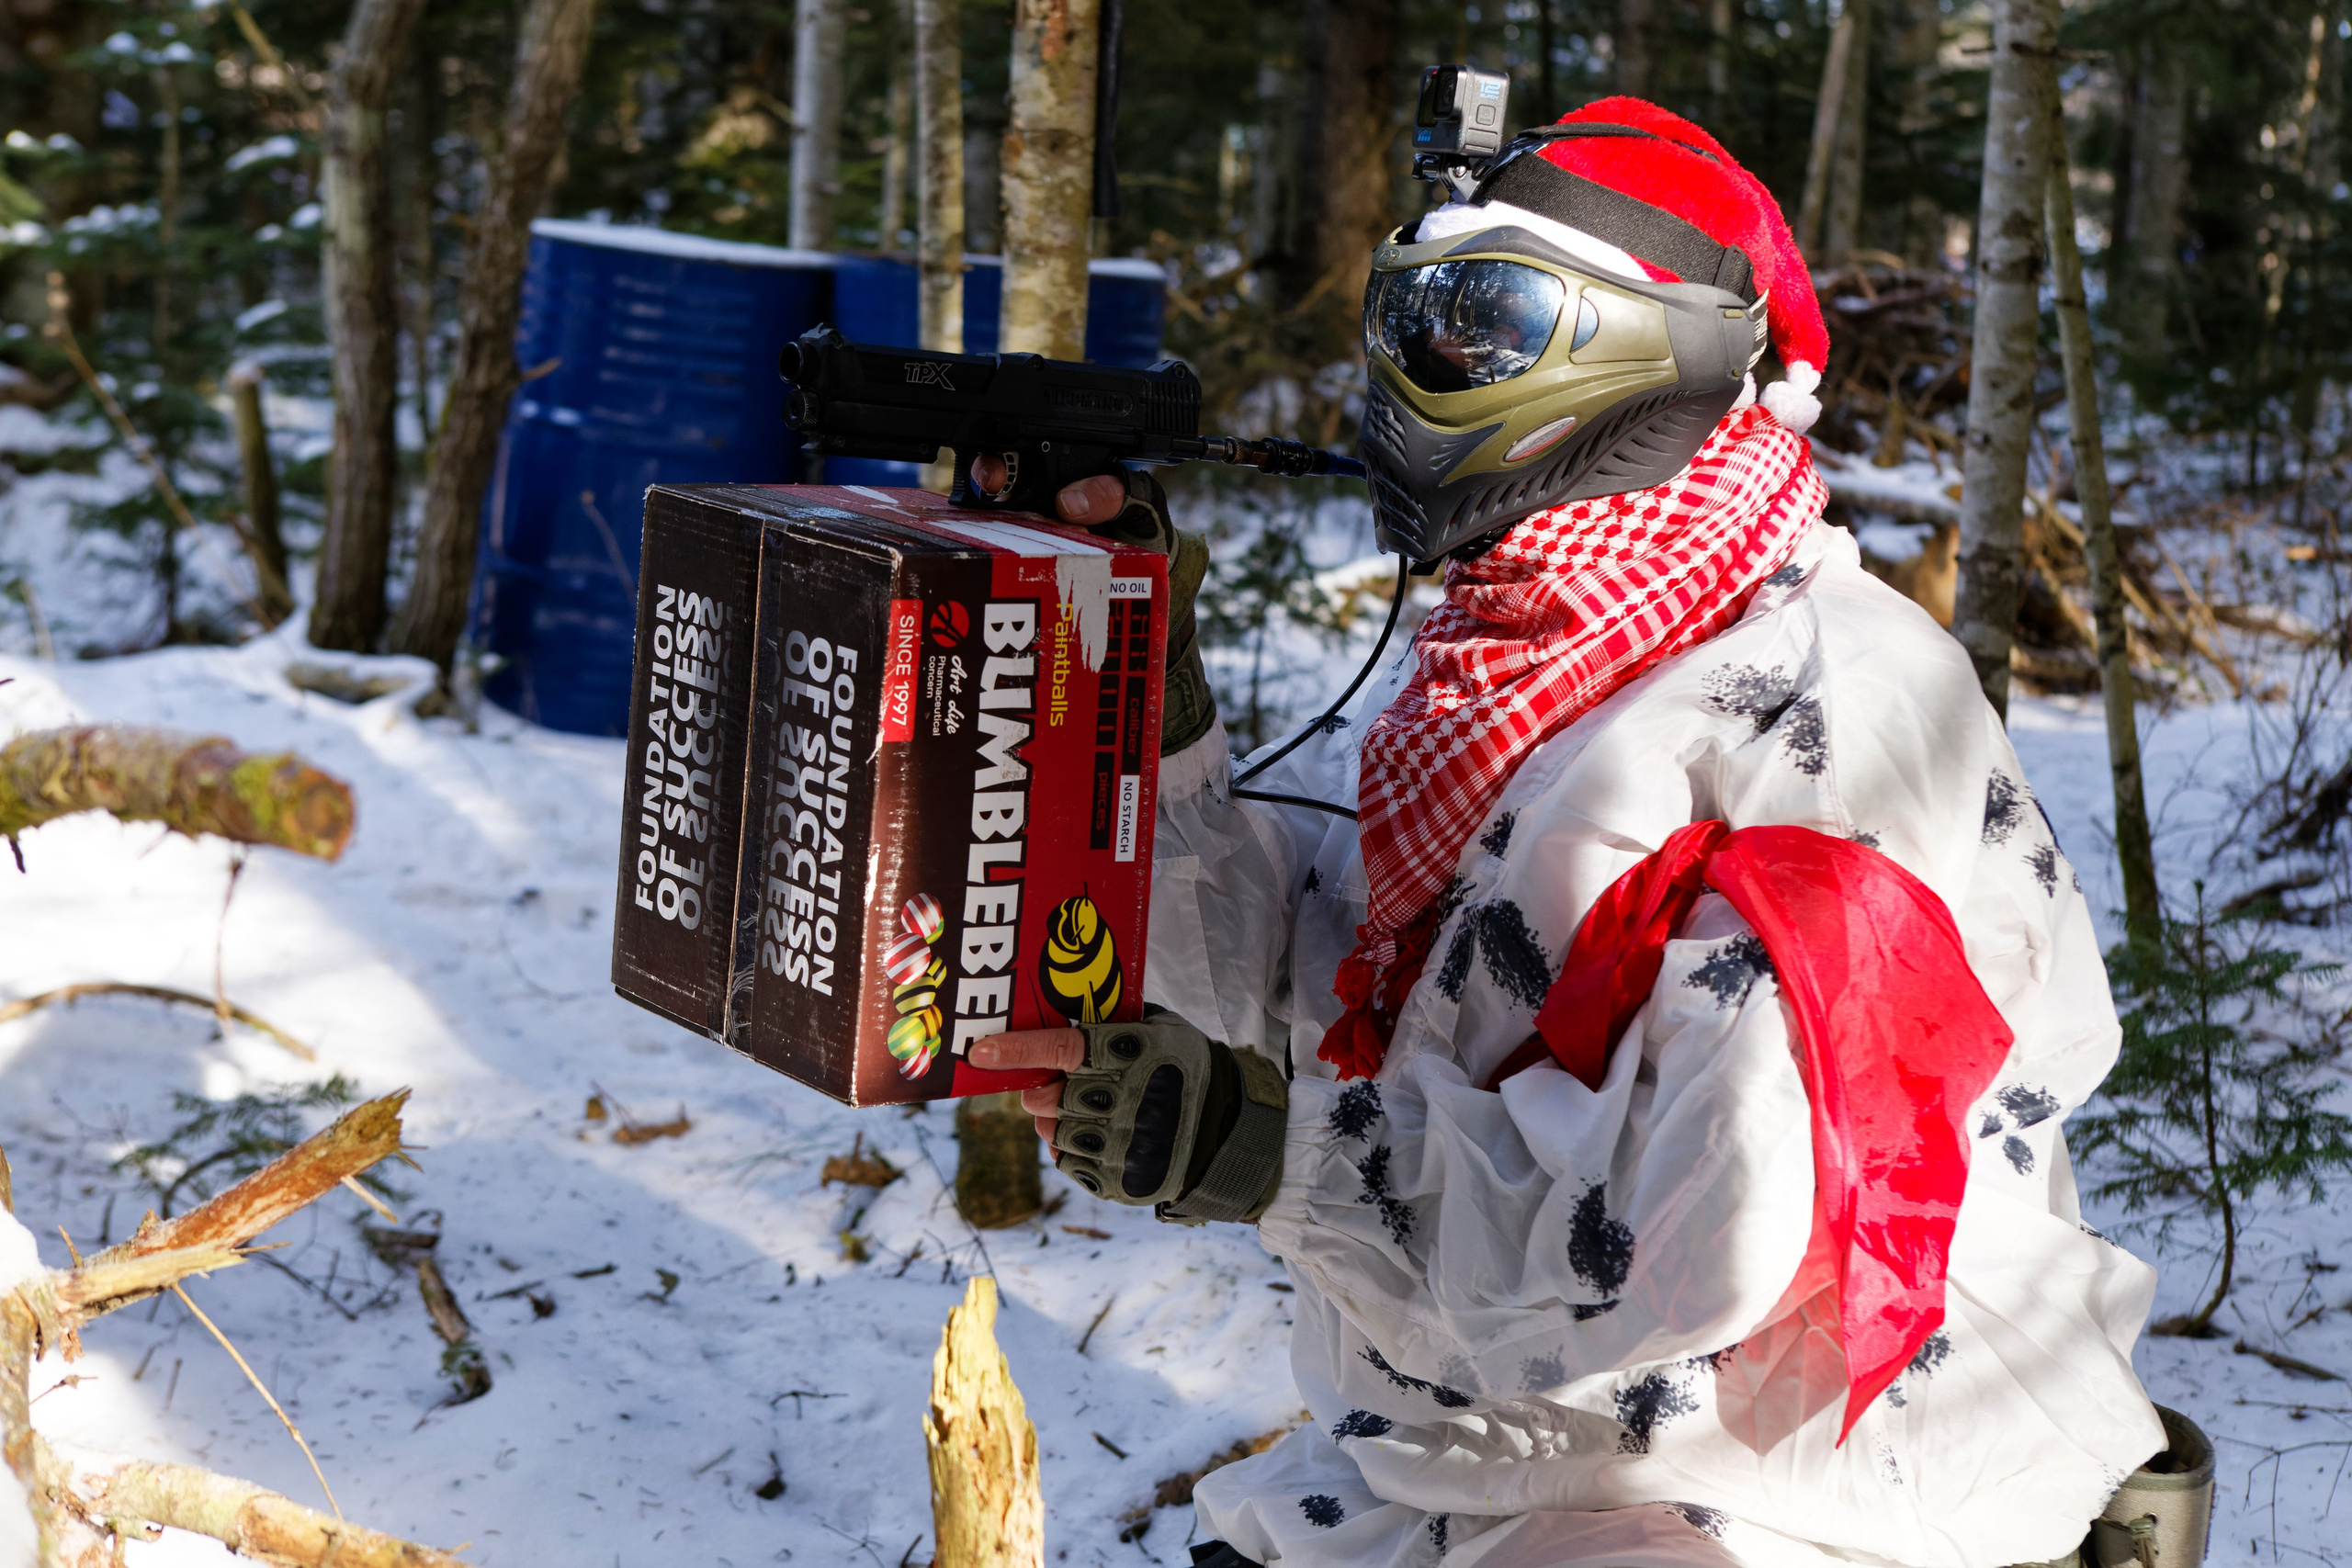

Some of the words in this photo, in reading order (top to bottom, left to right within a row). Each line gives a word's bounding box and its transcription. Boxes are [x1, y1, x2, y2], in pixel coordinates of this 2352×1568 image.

[1479, 79, 1501, 95] 12
[1110, 582, 1126, 593] NO
[1129, 582, 1147, 593] OIL
[896, 615, 915, 676] SINCE
[949, 655, 968, 695] Art
[1049, 603, 1073, 728] Paintballs
[806, 637, 833, 718] OF
[891, 681, 910, 727] 1997
[926, 655, 936, 699] concern
[933, 655, 946, 736] Pharmaceutical
[662, 588, 701, 836] SUCCESS
[944, 700, 965, 735] Life
[1126, 697, 1140, 757] caliber
[635, 583, 676, 911] FOUNDATION
[811, 644, 858, 997] FOUNDATION
[1095, 772, 1110, 831] pieces
[1122, 782, 1133, 803] NO
[785, 728, 827, 988] SUCCESS
[950, 603, 1036, 1057] BUMBLEBEE
[1120, 806, 1132, 854] STARCH
[656, 844, 684, 921] OF
